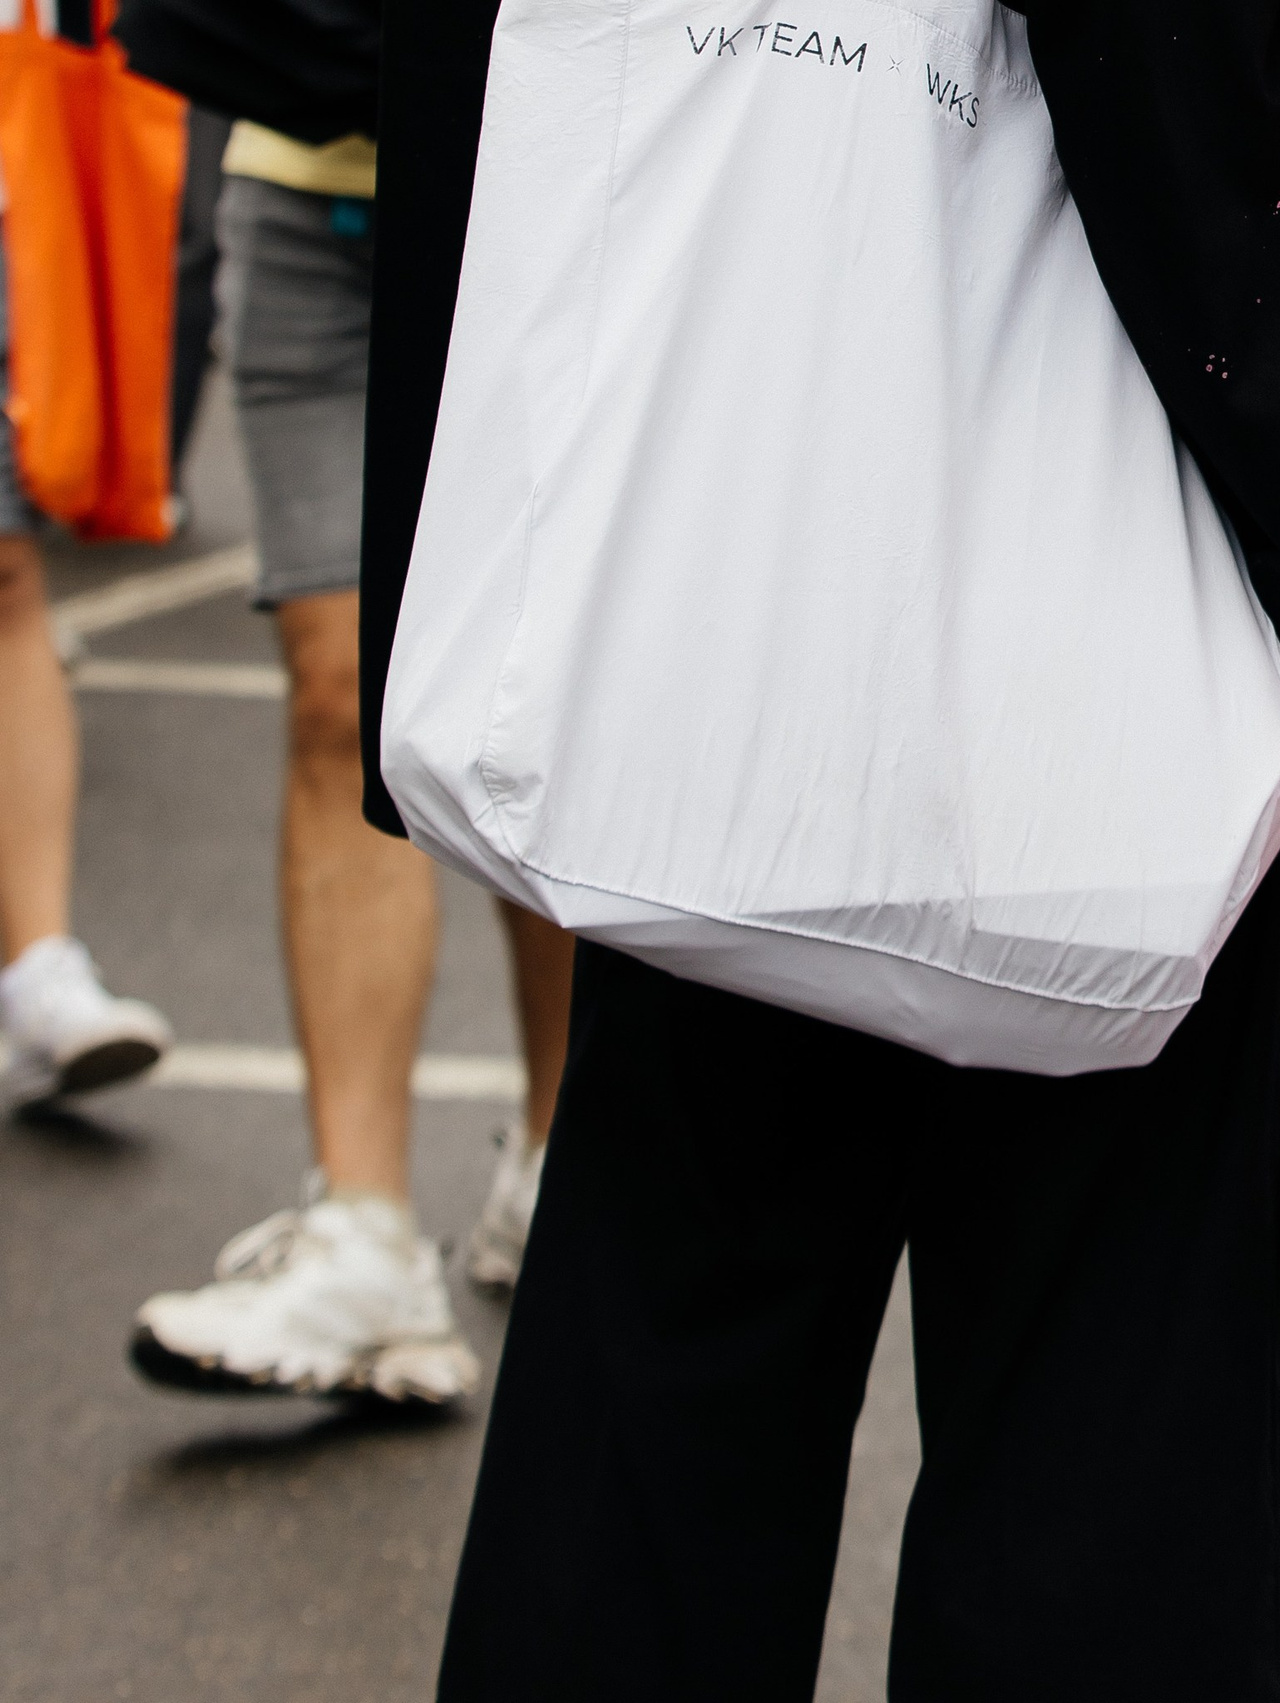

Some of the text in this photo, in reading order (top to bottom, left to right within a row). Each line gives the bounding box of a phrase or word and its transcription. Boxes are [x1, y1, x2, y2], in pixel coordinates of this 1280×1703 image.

[685, 22, 981, 129] VK TEAM WKS
